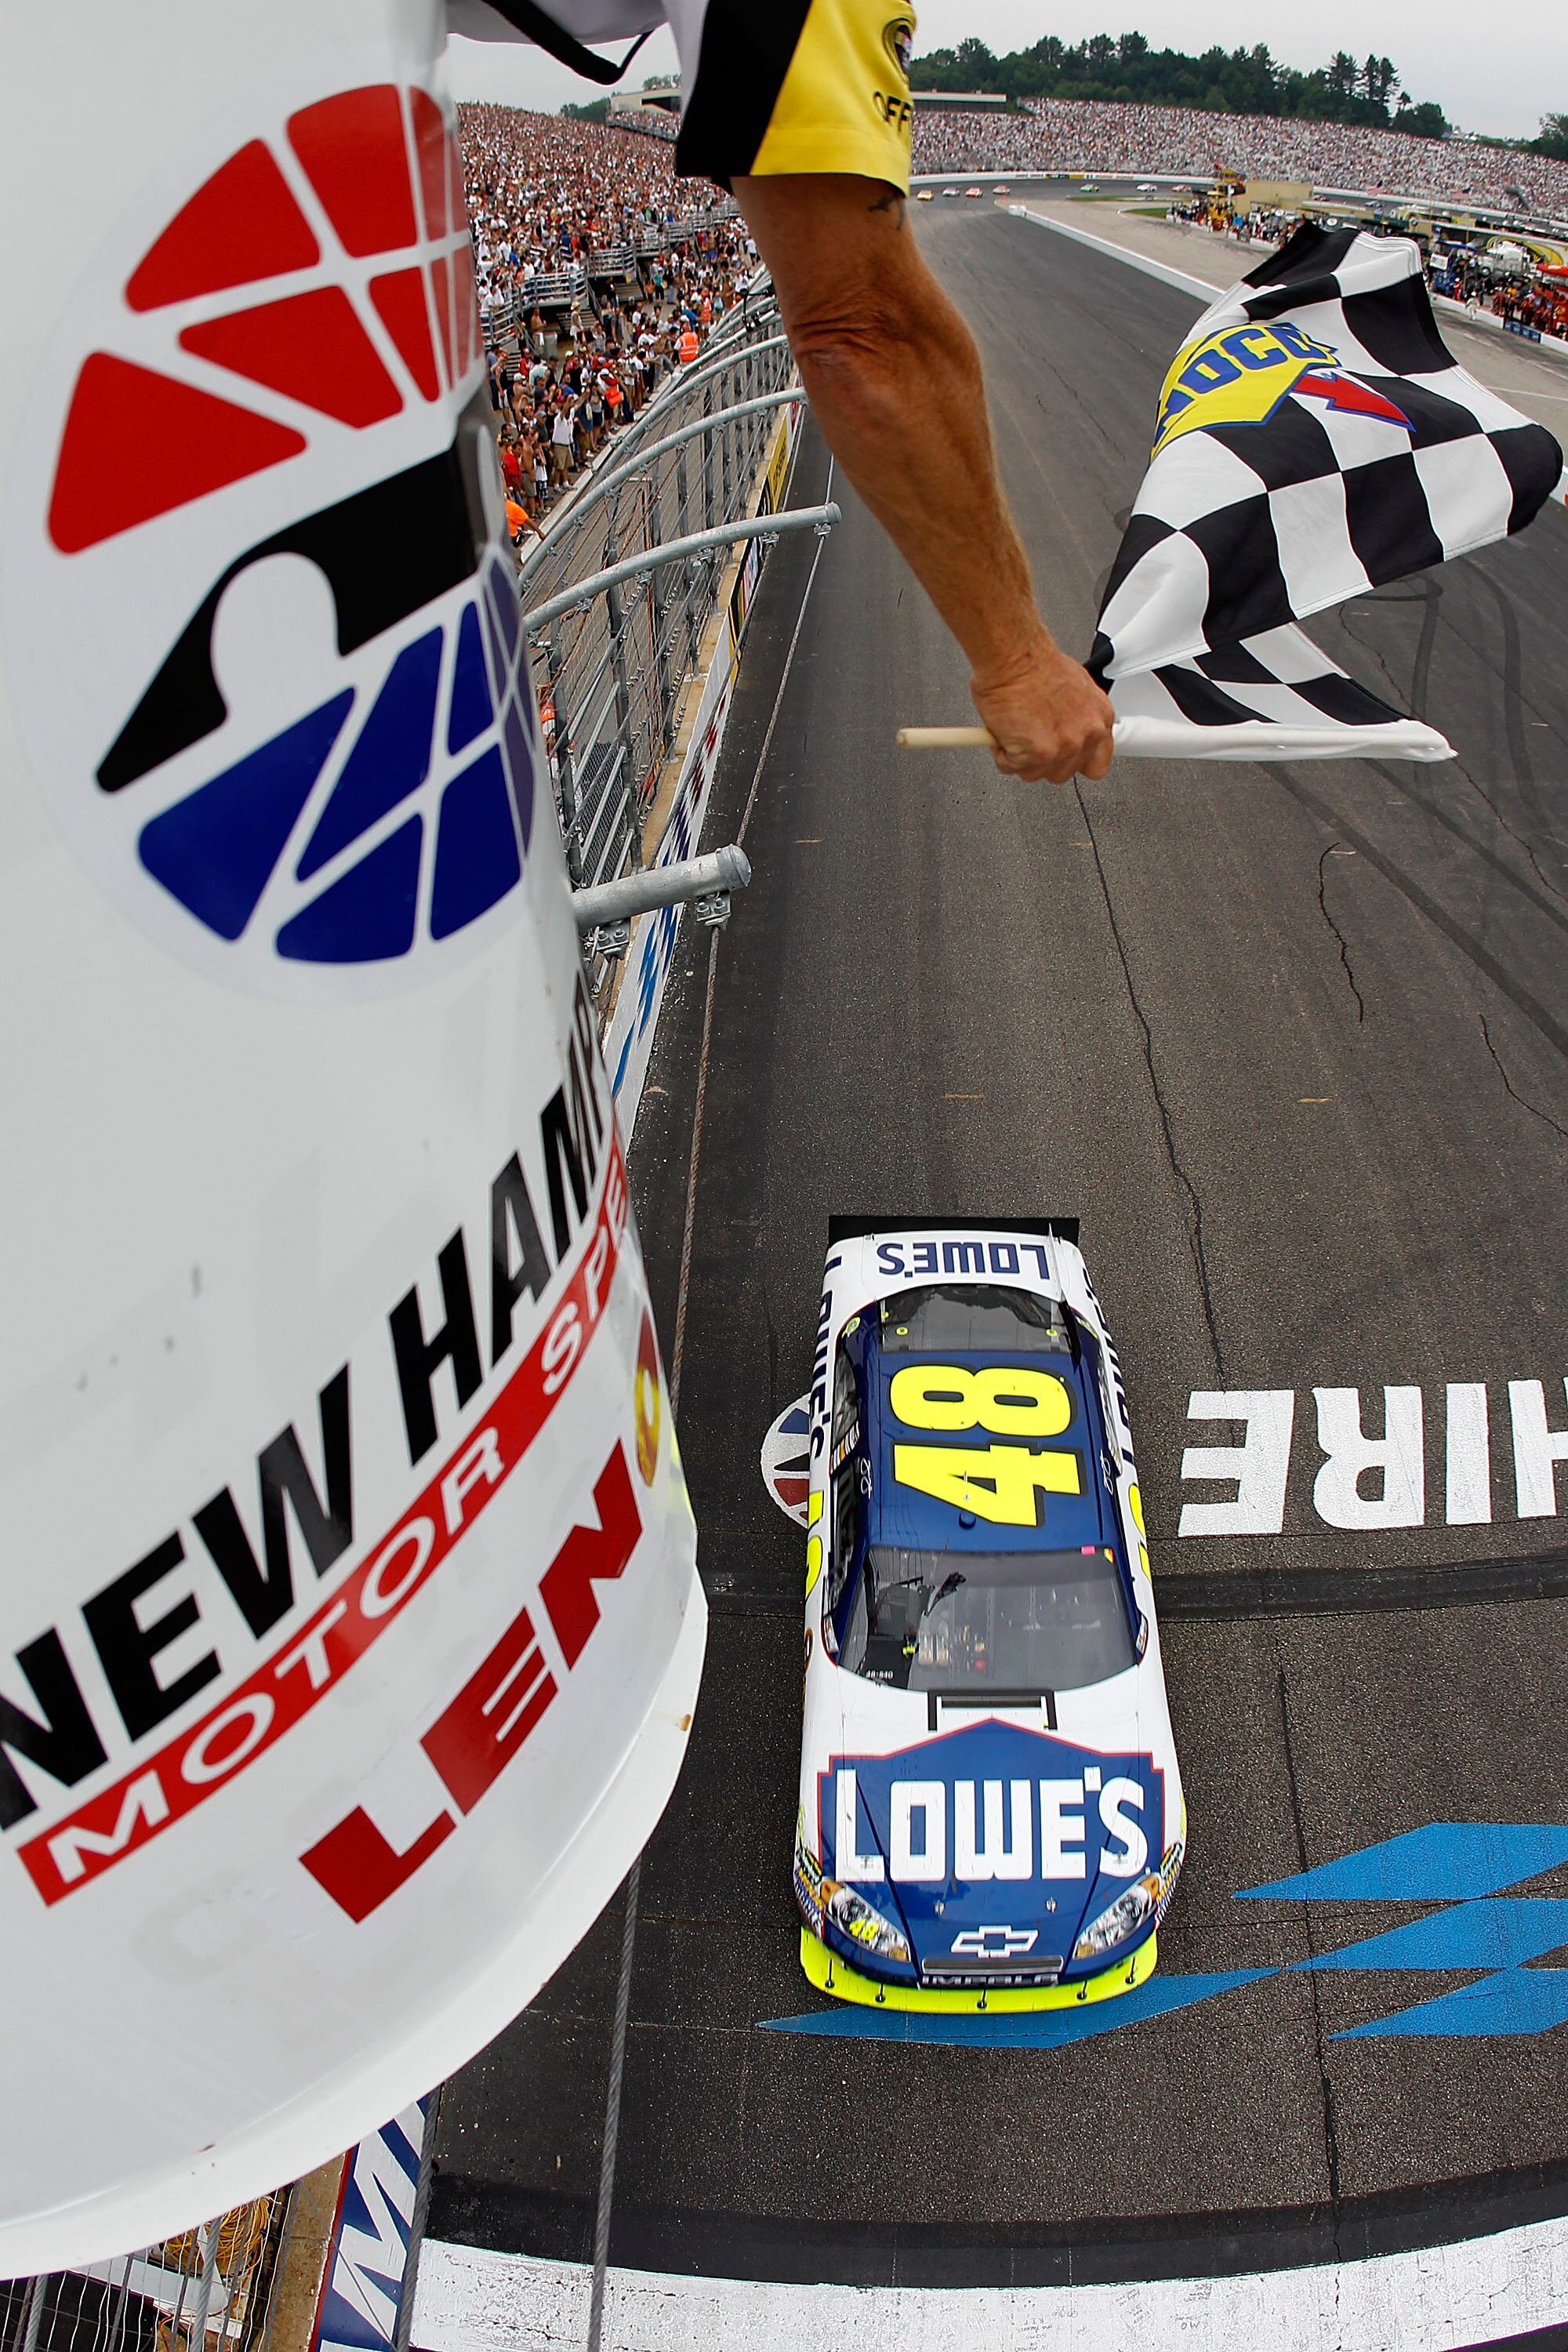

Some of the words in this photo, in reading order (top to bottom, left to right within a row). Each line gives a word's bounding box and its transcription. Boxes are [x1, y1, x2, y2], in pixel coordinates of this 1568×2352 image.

[876, 1241, 1051, 1281] LOWE'S
[0, 1362, 353, 1831] NEW
[388, 972, 607, 1467] HAMP
[889, 1364, 1082, 1527] 48
[45, 1425, 506, 1884] MOTOR
[834, 1766, 1149, 1882] LOWE'S
[849, 1918, 879, 1941] 48
